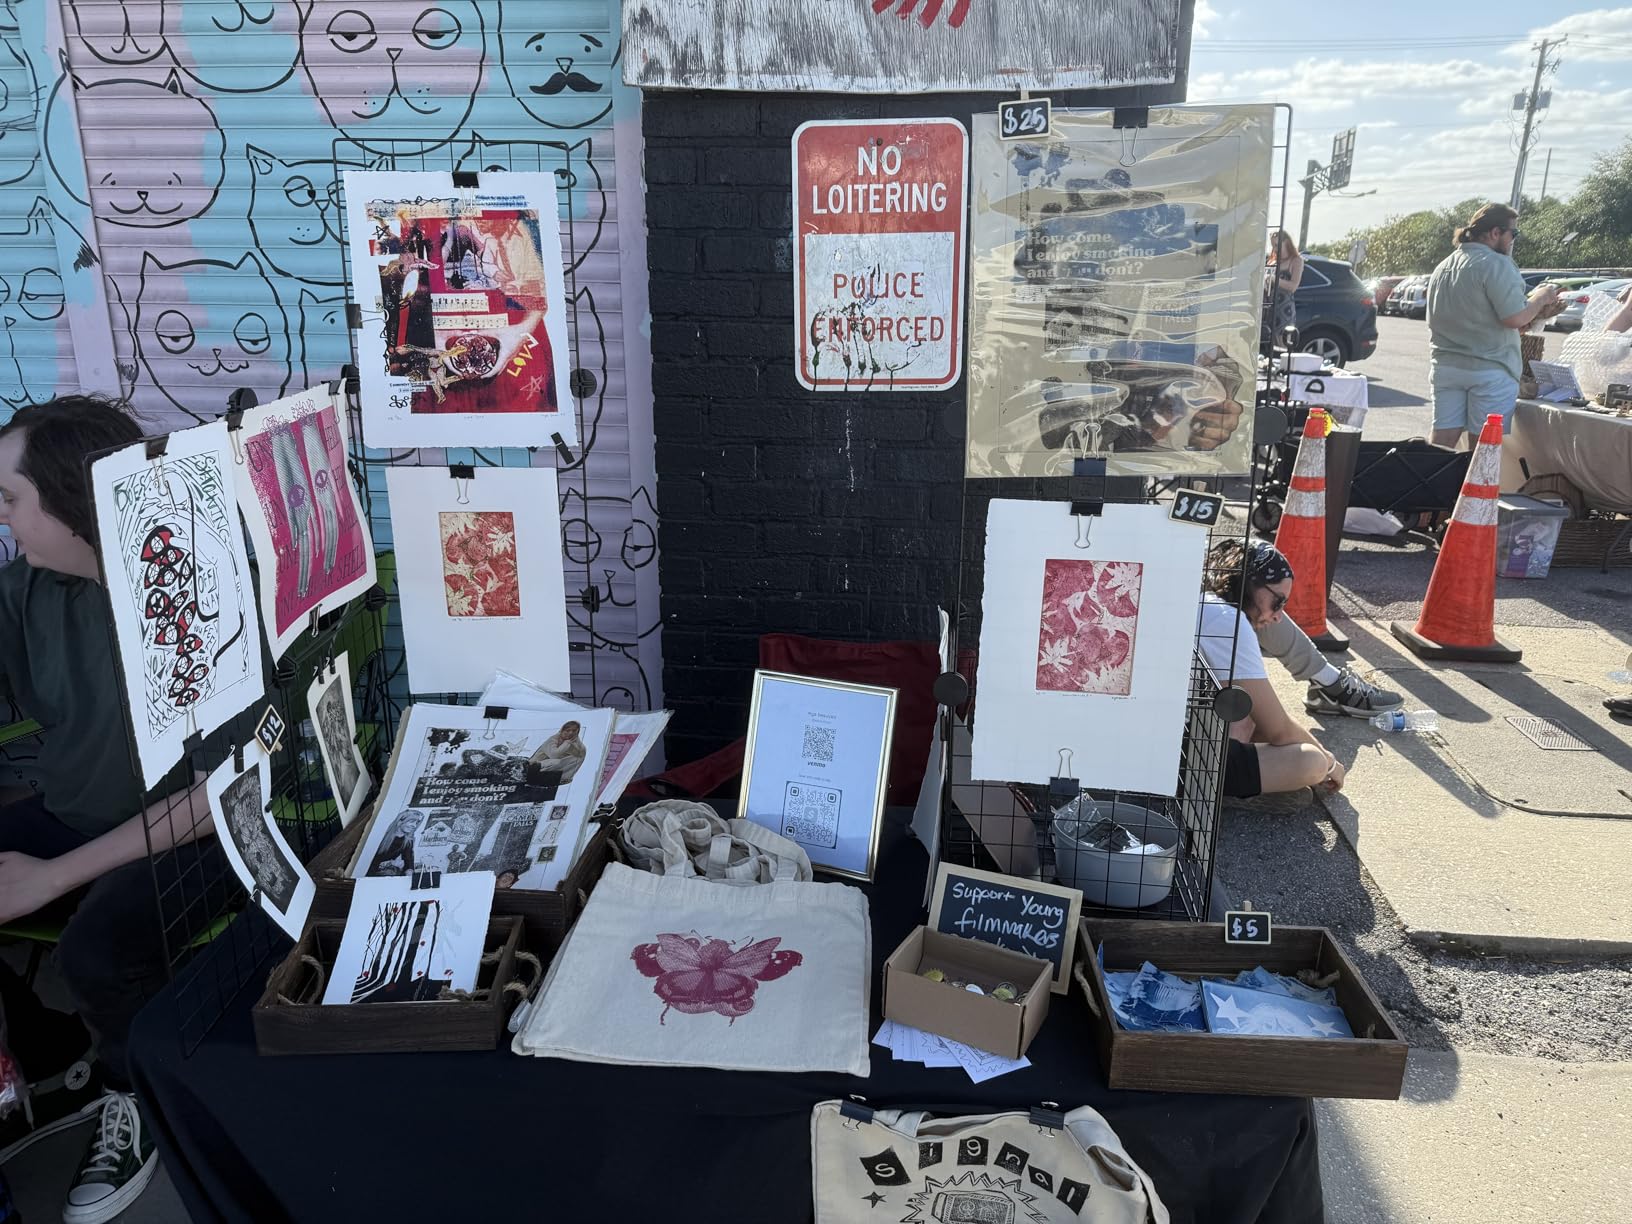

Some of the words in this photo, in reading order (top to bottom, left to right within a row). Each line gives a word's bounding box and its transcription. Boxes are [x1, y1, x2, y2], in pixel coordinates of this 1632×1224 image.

[1003, 106, 1046, 134] $25
[857, 146, 902, 176] NO
[812, 182, 947, 214] LOITERING
[1026, 231, 1065, 245] How
[1067, 231, 1112, 244] come
[1026, 245, 1034, 261] I
[1027, 264, 1057, 278] and
[833, 272, 925, 299] POLICE
[812, 316, 945, 342] ENFORCED
[506, 332, 539, 378] LOVE
[1175, 495, 1215, 519] $15
[261, 715, 280, 744] $12
[425, 777, 453, 786] How
[455, 777, 488, 785] come
[428, 786, 462, 795] enjoy
[463, 784, 517, 794] smoking
[419, 796, 443, 804] and
[952, 882, 1016, 906] Support
[1020, 895, 1064, 929] Young
[1231, 917, 1259, 938] $5
